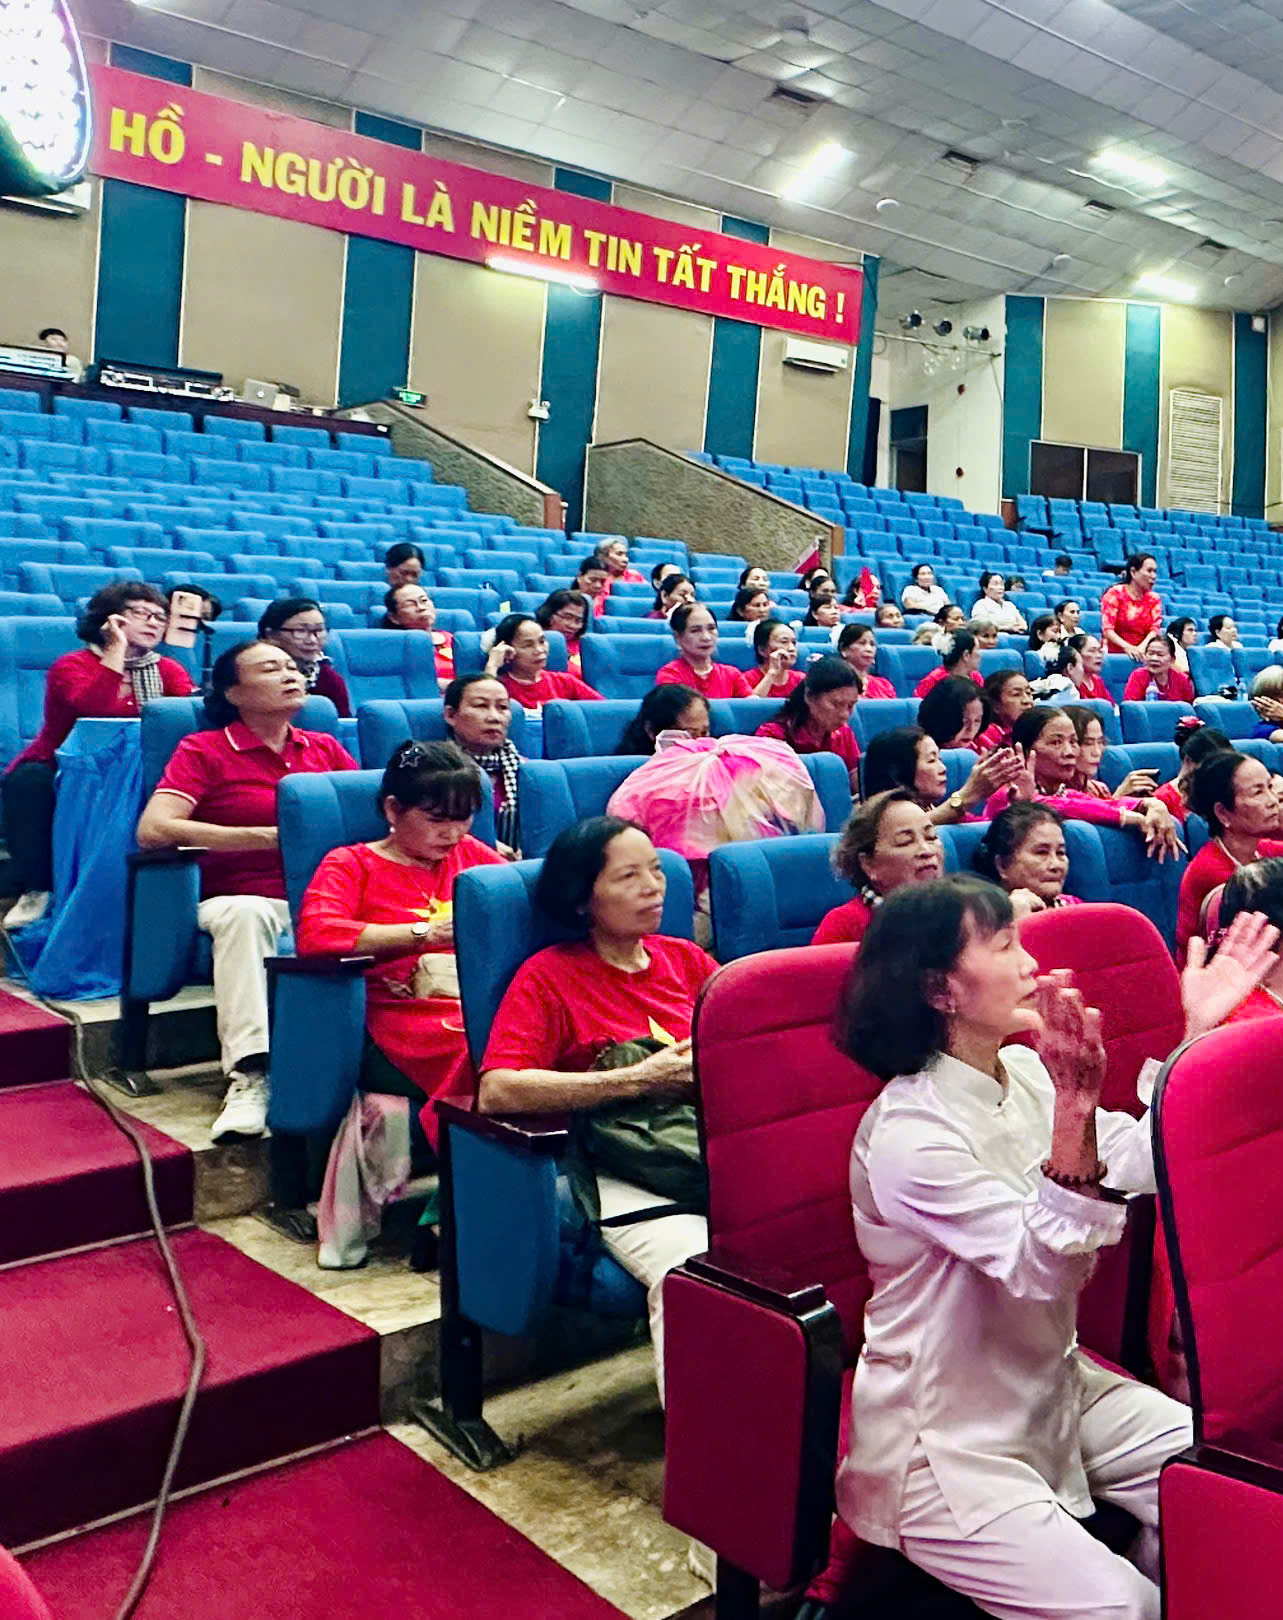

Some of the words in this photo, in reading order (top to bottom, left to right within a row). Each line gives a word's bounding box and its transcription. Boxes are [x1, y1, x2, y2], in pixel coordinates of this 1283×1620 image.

[109, 101, 185, 165] HỒ
[205, 153, 223, 166] -
[240, 141, 385, 216] NGƯỜI
[401, 180, 455, 233] LÀ
[471, 199, 572, 261] NIỀM
[584, 229, 642, 277] TIN
[653, 243, 717, 293] TẤT
[727, 263, 826, 320] THẮNG
[835, 293, 845, 323] !
